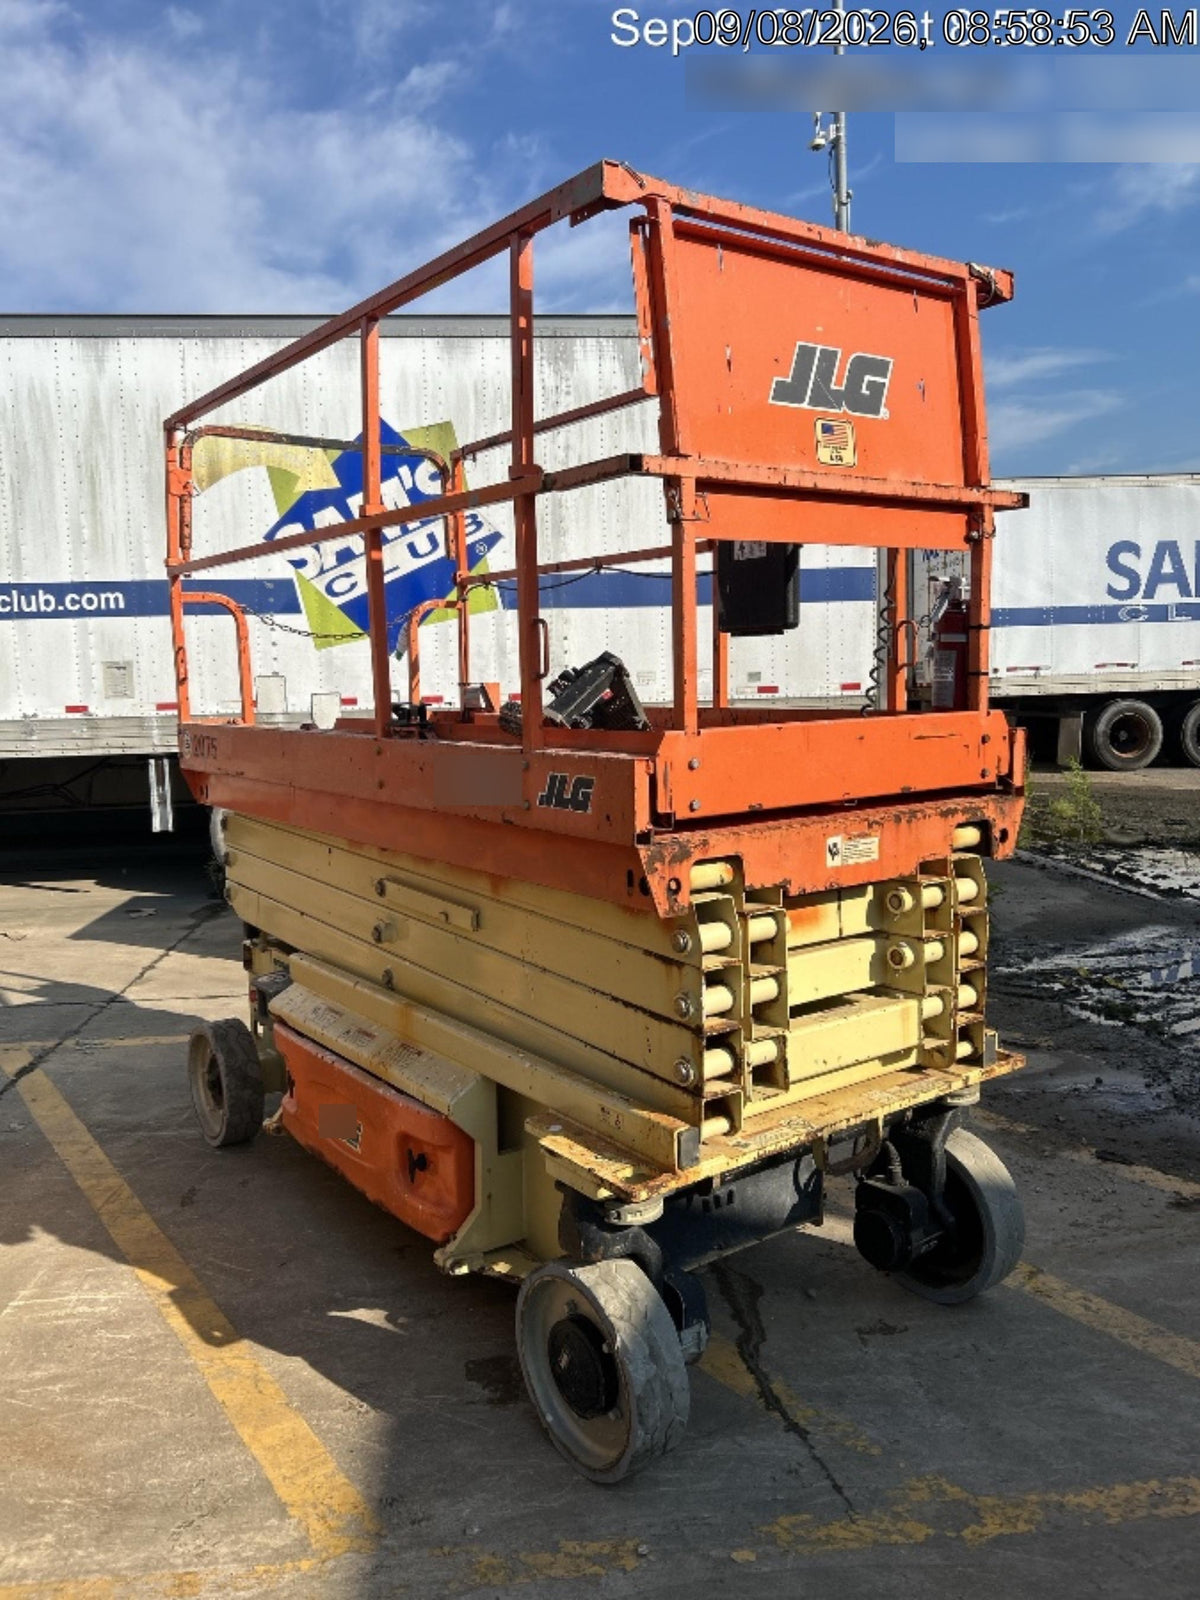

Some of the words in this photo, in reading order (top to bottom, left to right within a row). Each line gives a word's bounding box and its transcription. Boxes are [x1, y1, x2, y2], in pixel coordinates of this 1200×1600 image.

[768, 341, 893, 419] JLG
[1105, 539, 1200, 601] SA
[0, 589, 125, 613] club.com
[536, 771, 596, 814] JLG
